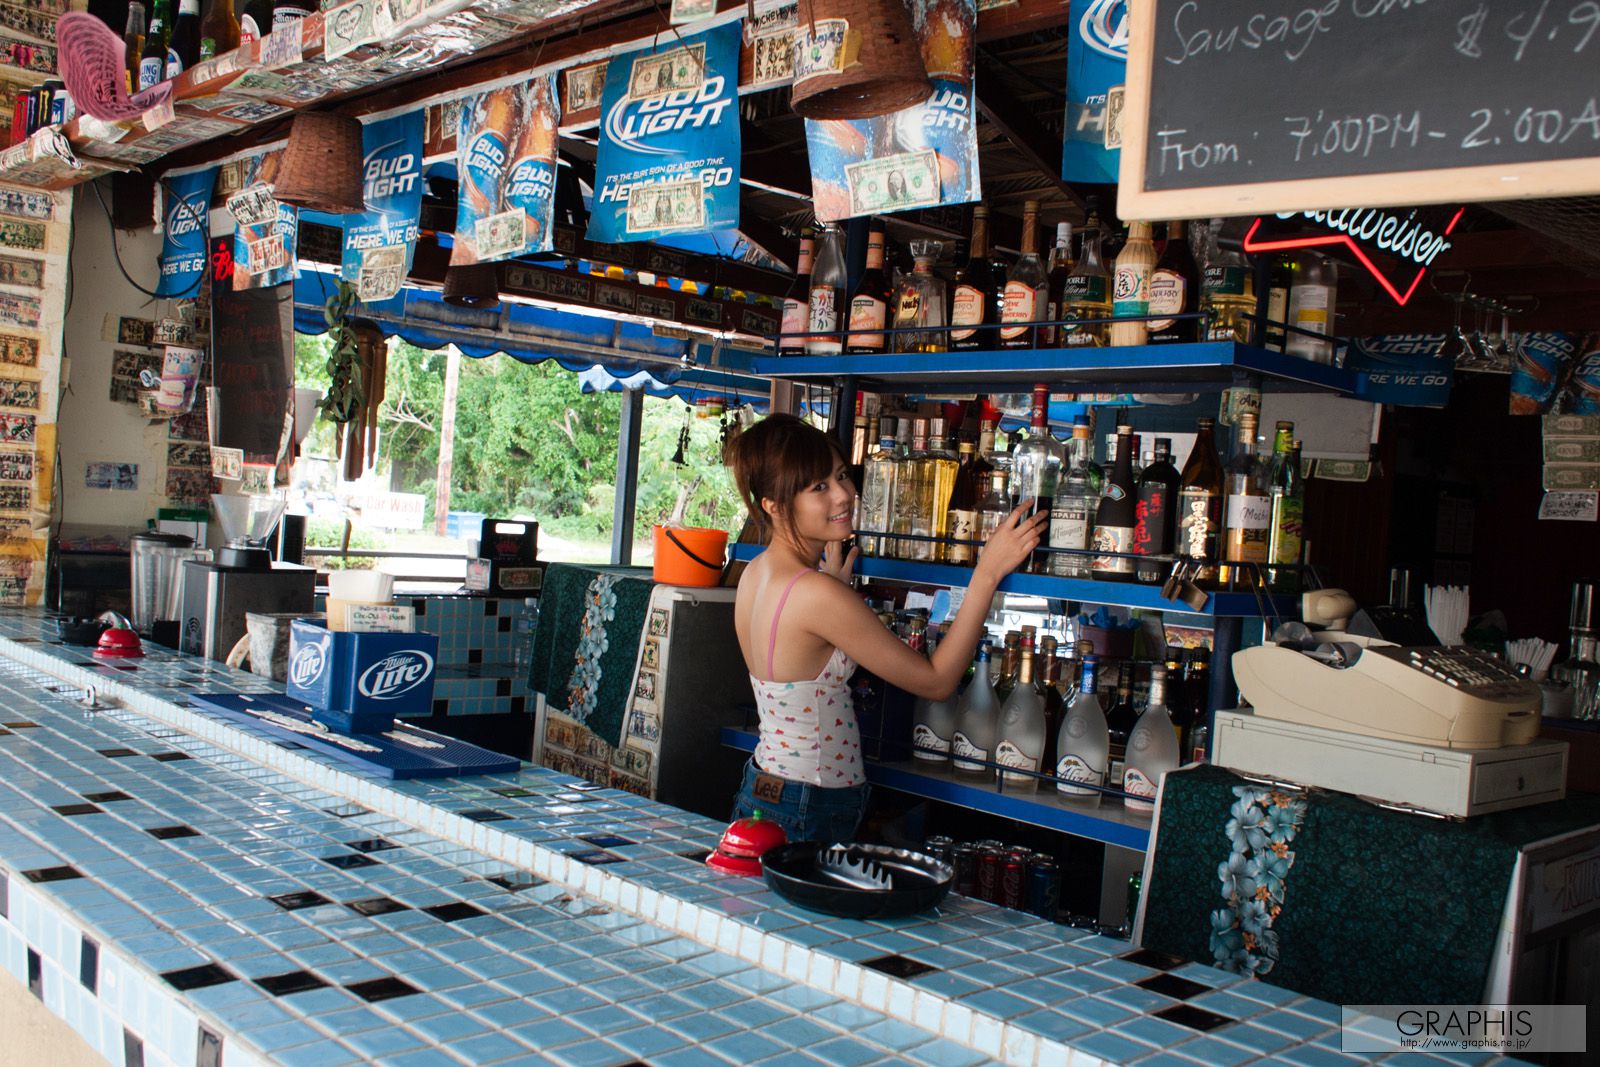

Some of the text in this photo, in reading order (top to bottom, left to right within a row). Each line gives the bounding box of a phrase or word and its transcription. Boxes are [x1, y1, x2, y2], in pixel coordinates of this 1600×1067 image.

[638, 76, 725, 113] BUD
[927, 90, 968, 112] UD
[1085, 94, 1106, 105] IT'S
[620, 98, 732, 141] LIGHT
[923, 110, 969, 130] GHT
[476, 138, 506, 164] BUD
[706, 156, 725, 166] TIME
[365, 153, 414, 180] BUD
[467, 151, 503, 178] LIGHT
[367, 172, 420, 199] IGHT
[512, 165, 553, 186] BUD
[505, 181, 551, 200] LIGHT
[177, 201, 206, 220] BUD
[170, 215, 206, 236] LIGHT
[346, 226, 418, 250] HERE WE GO
[1276, 208, 1451, 266] dweiser
[162, 262, 179, 275] HERE
[180, 260, 191, 272] WE
[1066, 276, 1086, 285] OIRE
[1368, 373, 1448, 386] RE WE GO
[391, 496, 422, 513] Wash
[1052, 511, 1082, 520] MPARI
[296, 655, 321, 683] Lite
[381, 655, 415, 670] Miller
[370, 663, 423, 697] Lite
[754, 782, 779, 799] Lee
